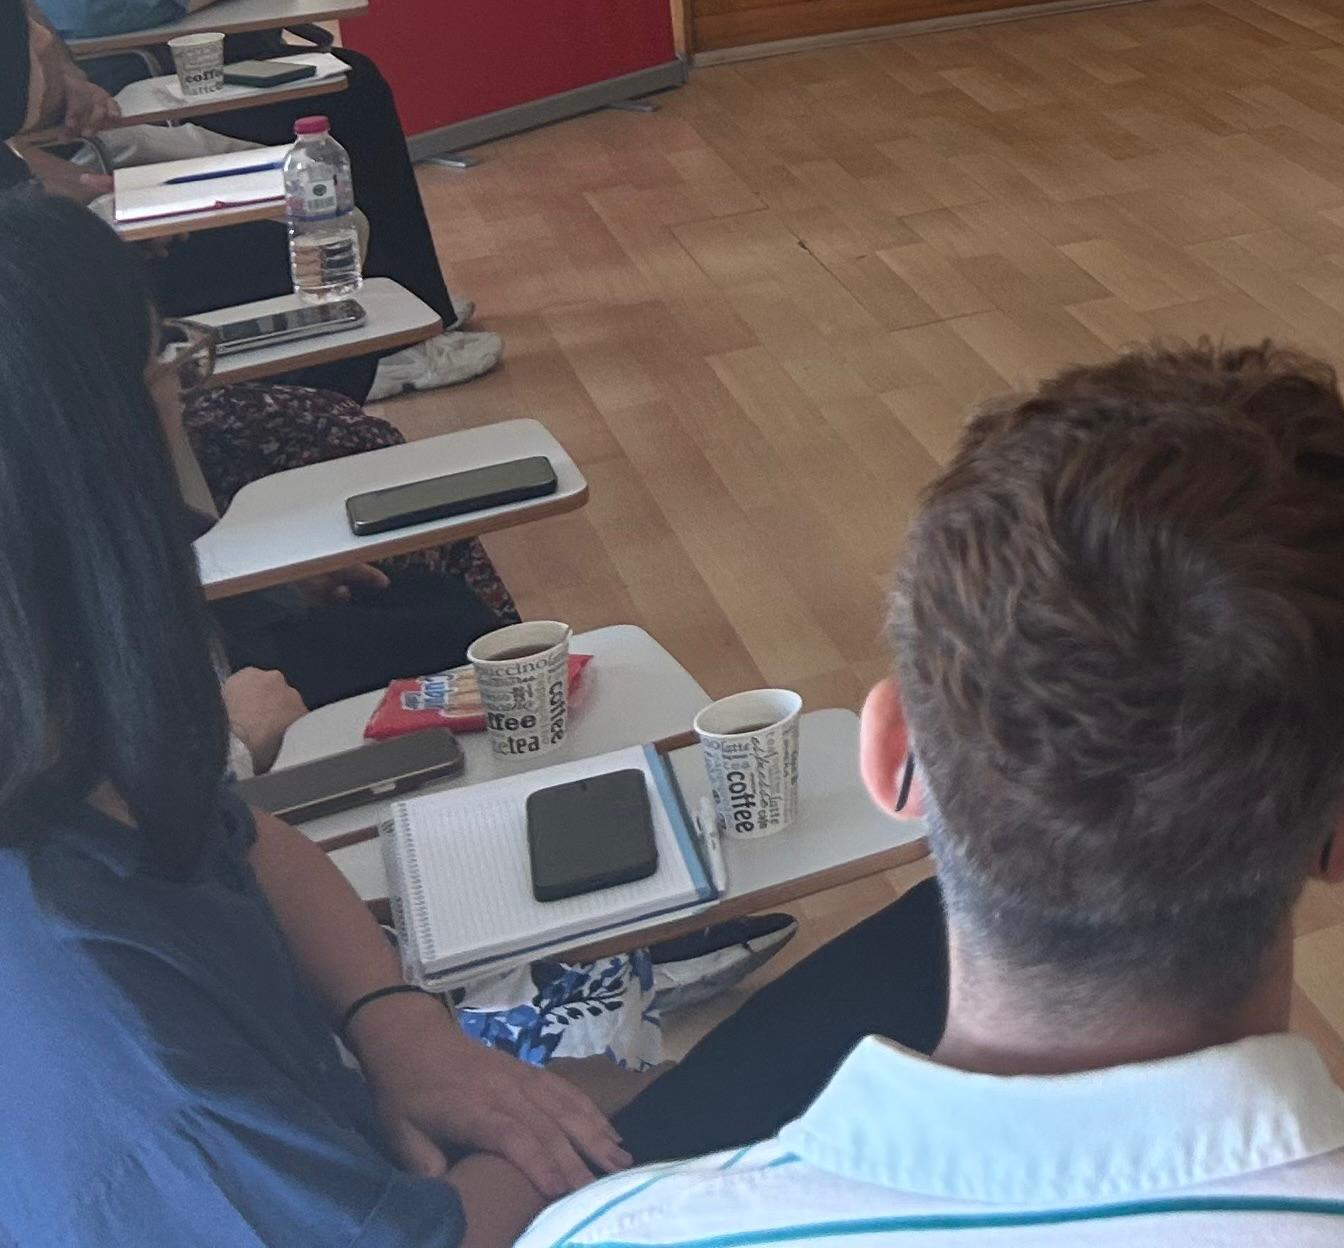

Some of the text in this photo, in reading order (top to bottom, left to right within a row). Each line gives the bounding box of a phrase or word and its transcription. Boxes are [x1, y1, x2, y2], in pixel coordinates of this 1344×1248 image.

[487, 712, 537, 731] ffee
[549, 681, 566, 744] coffee
[726, 771, 755, 833] coffee
